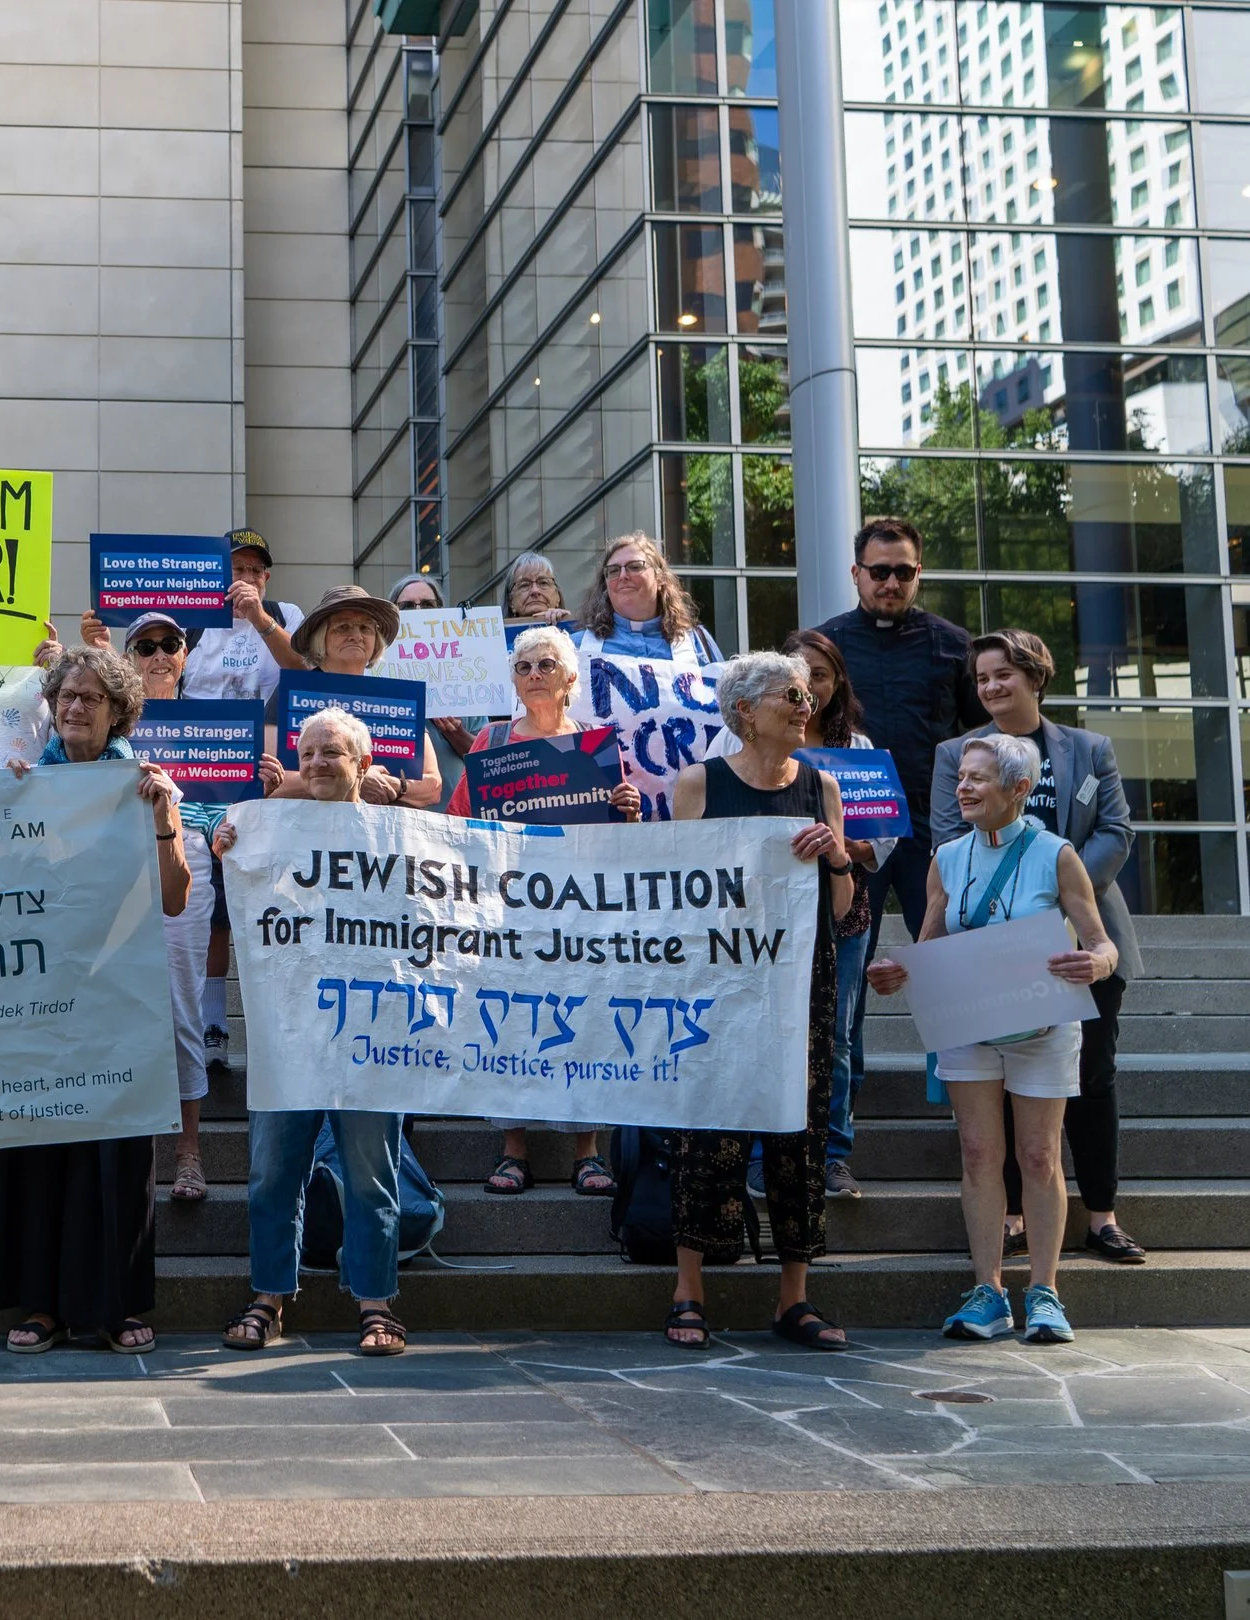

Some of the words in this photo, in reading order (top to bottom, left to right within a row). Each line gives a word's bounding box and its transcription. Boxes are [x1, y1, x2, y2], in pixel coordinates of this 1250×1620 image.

[103, 557, 135, 569] Love
[138, 558, 159, 569] the
[161, 558, 222, 572] Stranger.
[103, 578, 133, 588] Love
[135, 578, 165, 588] Your
[166, 578, 224, 591] Neighbor.
[102, 595, 155, 607] Together
[156, 596, 166, 605] in
[396, 617, 501, 640] ULTIVATE
[222, 654, 258, 667] ABUELO
[398, 641, 463, 660] LOVE
[370, 657, 488, 682] KINDNESS
[426, 683, 505, 708] ASSION
[590, 658, 720, 719] NO
[292, 695, 325, 709] Love
[328, 699, 350, 711] the
[352, 701, 415, 717] Stranger.
[129, 728, 153, 738] ove
[156, 726, 180, 738] the
[183, 726, 252, 741] Stranger.
[367, 723, 416, 738] eighbor.
[153, 748, 186, 759] Your
[188, 748, 254, 762] Neighbor.
[481, 750, 531, 768] Together
[176, 768, 187, 777] in
[483, 771, 490, 779] in
[490, 759, 540, 777] Welcome
[478, 772, 568, 801] Together
[841, 788, 895, 800] eighbor.
[480, 807, 499, 820] in
[502, 787, 614, 816] Community
[10, 821, 46, 840] AM
[292, 850, 479, 904] JEWISH
[499, 866, 747, 912] COALITION
[257, 906, 315, 946] for
[324, 907, 524, 968] Immigrant
[534, 927, 686, 965] Justice
[707, 927, 787, 966] NW
[29, 998, 76, 1016] Tirdof
[316, 976, 458, 1041] תרדף
[475, 987, 589, 1054] צדק
[608, 995, 716, 1058] צדק
[352, 1034, 451, 1072] Justice,
[565, 1058, 644, 1090] pursue
[652, 1053, 679, 1082] it!
[1, 1076, 50, 1095] heart,
[54, 1072, 86, 1089] and
[92, 1068, 133, 1086] mind
[8, 1104, 27, 1120] of
[27, 1101, 89, 1122] justice.
